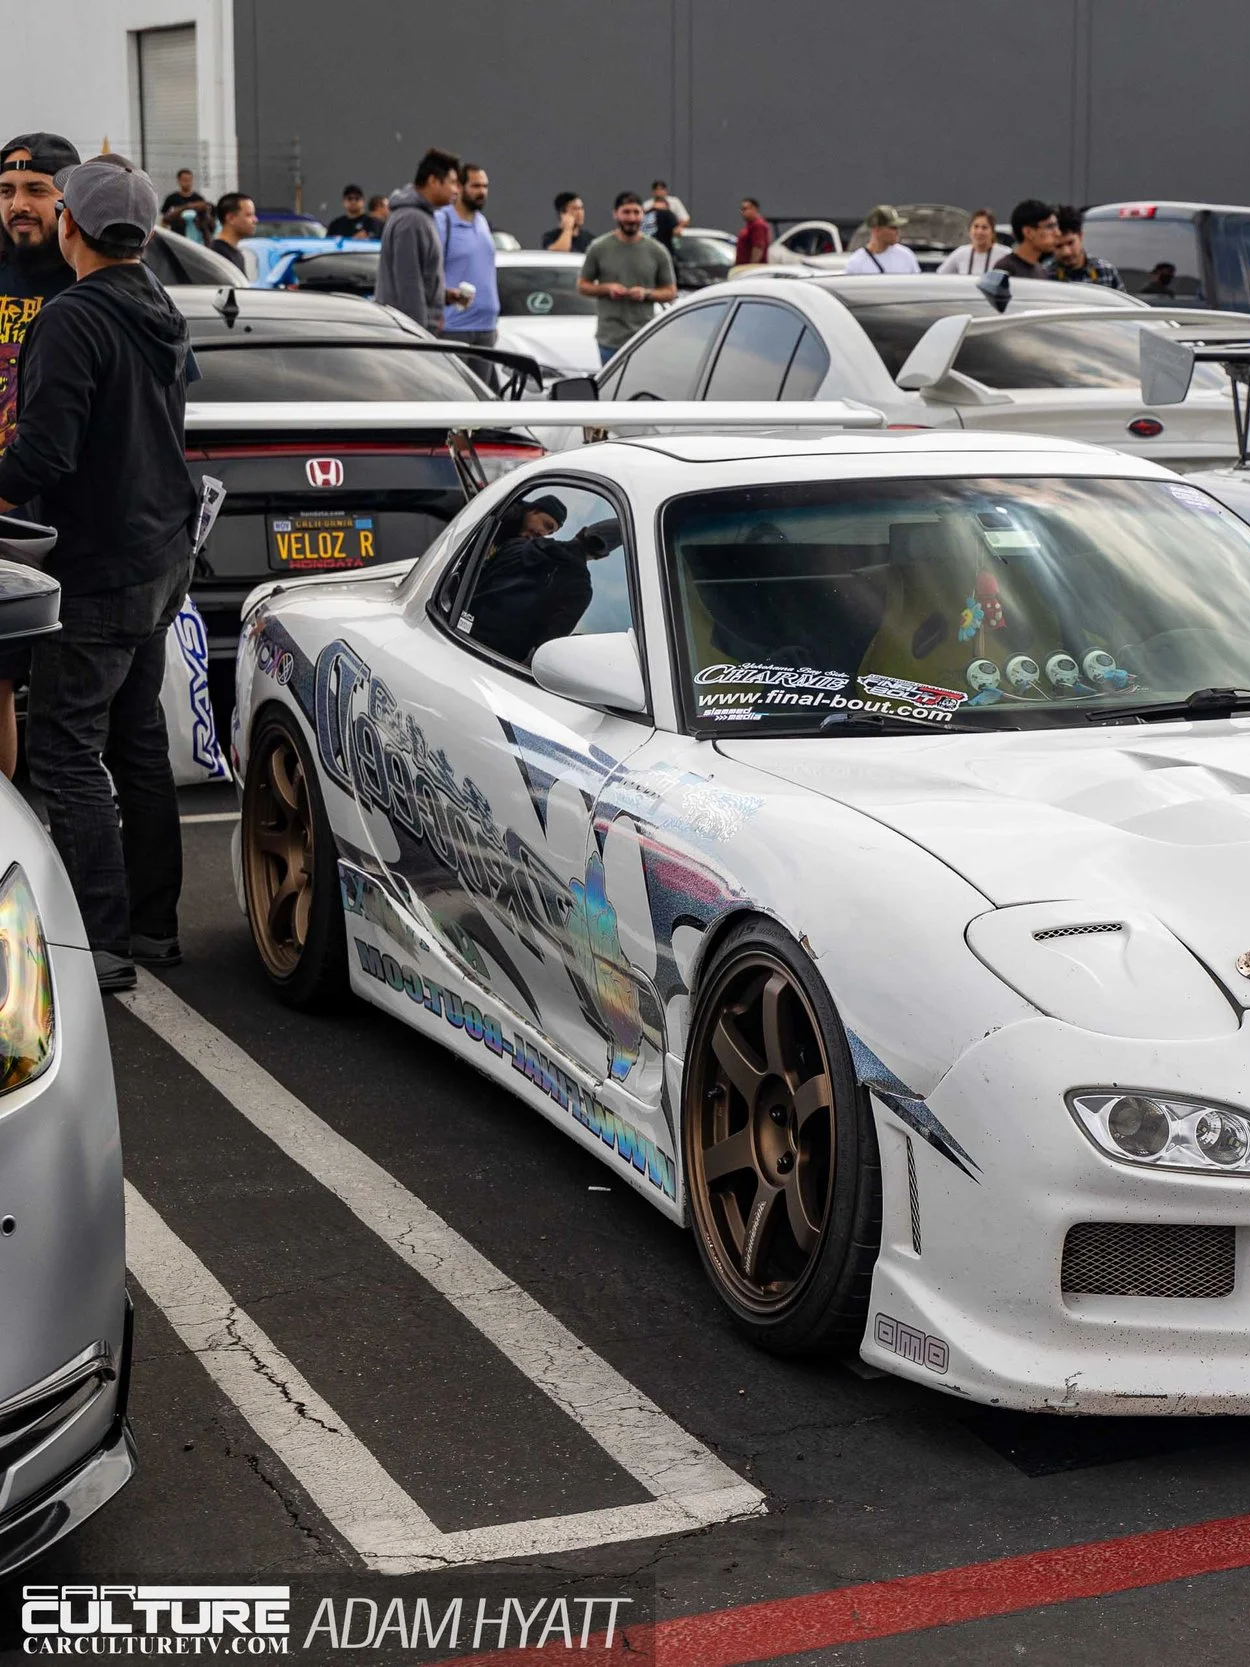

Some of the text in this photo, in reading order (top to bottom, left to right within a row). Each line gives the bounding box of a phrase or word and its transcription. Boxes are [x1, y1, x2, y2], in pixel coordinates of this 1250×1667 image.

[295, 519, 353, 529] CALIFORNIA
[276, 530, 375, 560] VELOZ R
[175, 608, 223, 774] RAYS
[694, 664, 850, 691] CHARME
[698, 689, 953, 722] www.final-bout.com
[703, 707, 753, 716] slammed
